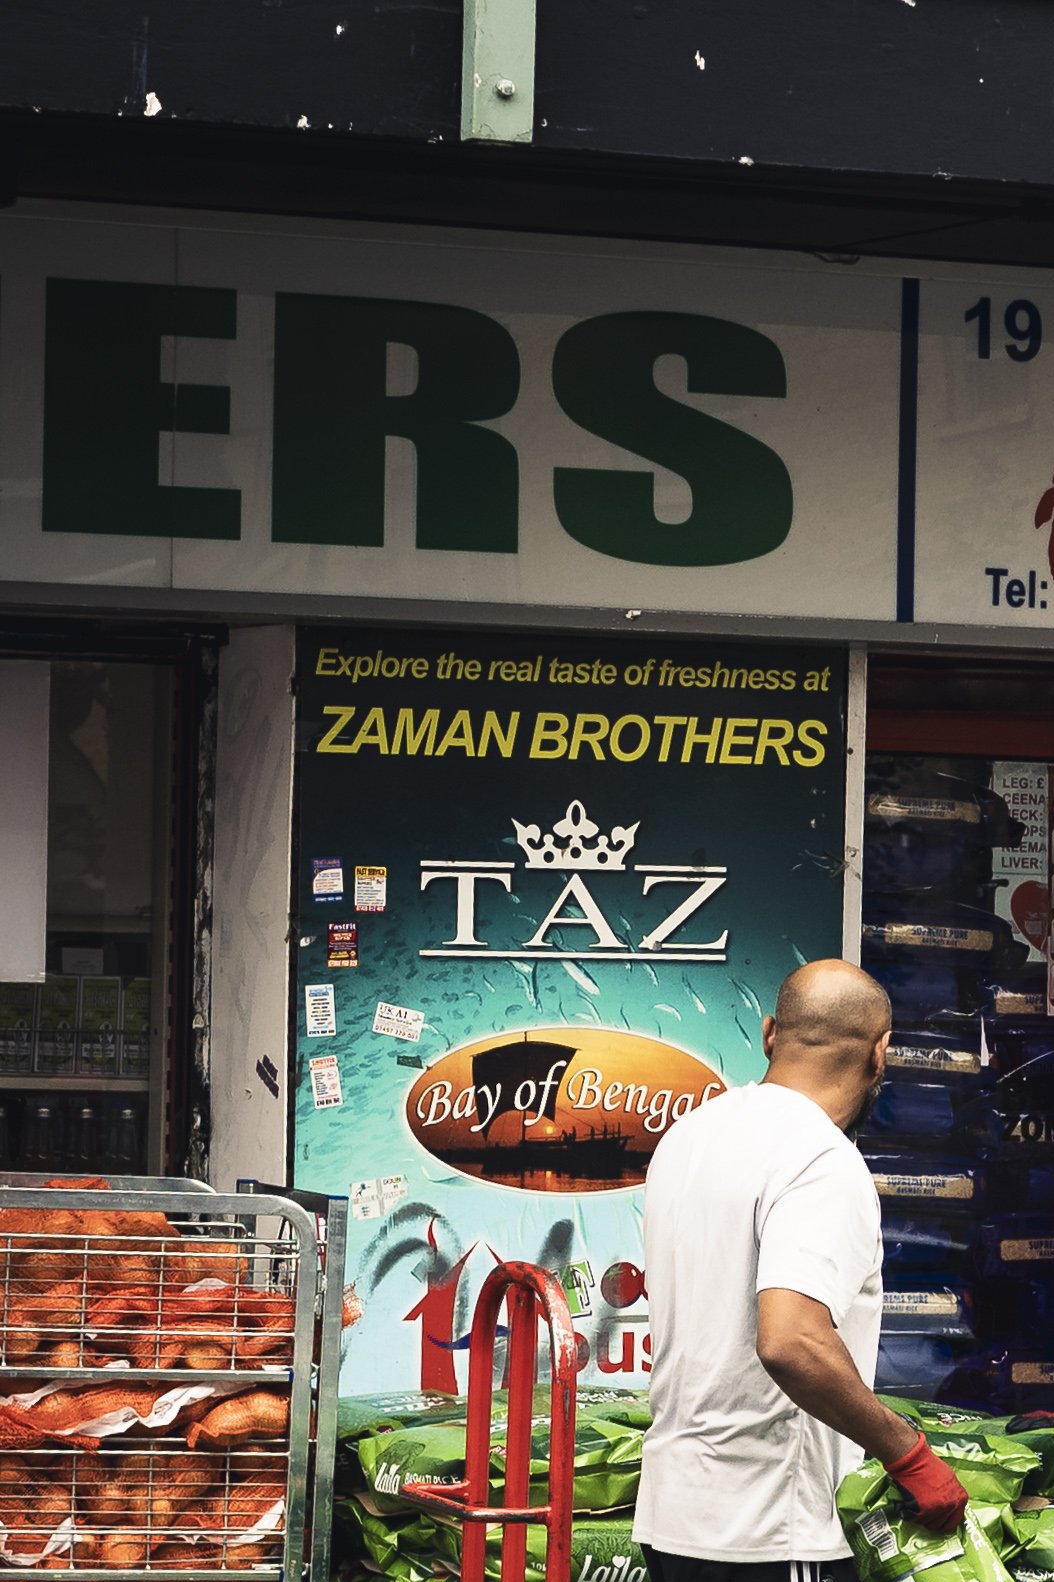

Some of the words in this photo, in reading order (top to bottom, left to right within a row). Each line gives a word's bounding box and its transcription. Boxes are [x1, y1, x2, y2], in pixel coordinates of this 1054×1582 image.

[964, 297, 1042, 362] 19
[42, 277, 794, 567] ERS
[985, 567, 1048, 609] Tel:
[316, 648, 429, 683] Explore
[437, 653, 482, 680] the
[488, 655, 542, 682] real
[549, 657, 617, 684] taste
[624, 659, 656, 686] of
[659, 659, 797, 691] freshness
[803, 667, 831, 691] at
[317, 706, 521, 758] ZAMAN
[529, 712, 828, 767] BROTHERS
[1002, 778, 1034, 789] LEG:
[1002, 857, 1042, 869] LIVER:
[420, 872, 729, 950] TAZ
[416, 1080, 502, 1133] Bay
[514, 1060, 568, 1126] of
